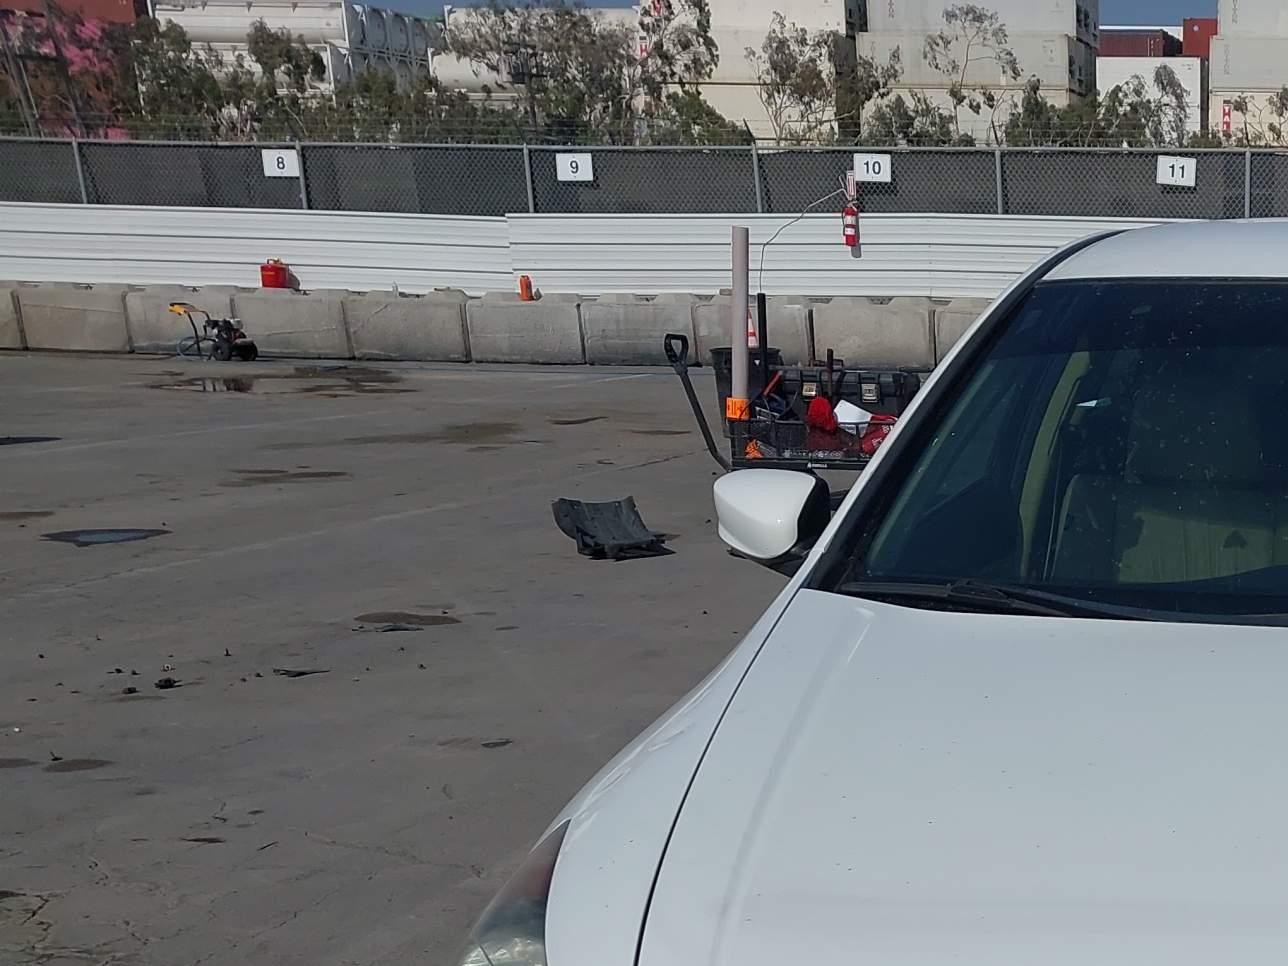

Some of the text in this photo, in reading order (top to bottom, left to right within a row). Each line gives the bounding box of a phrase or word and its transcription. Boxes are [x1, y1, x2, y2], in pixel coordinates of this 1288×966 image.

[276, 156, 285, 170] 8
[569, 160, 579, 174] 9
[863, 160, 882, 175] 10
[1168, 163, 1185, 179] 11
